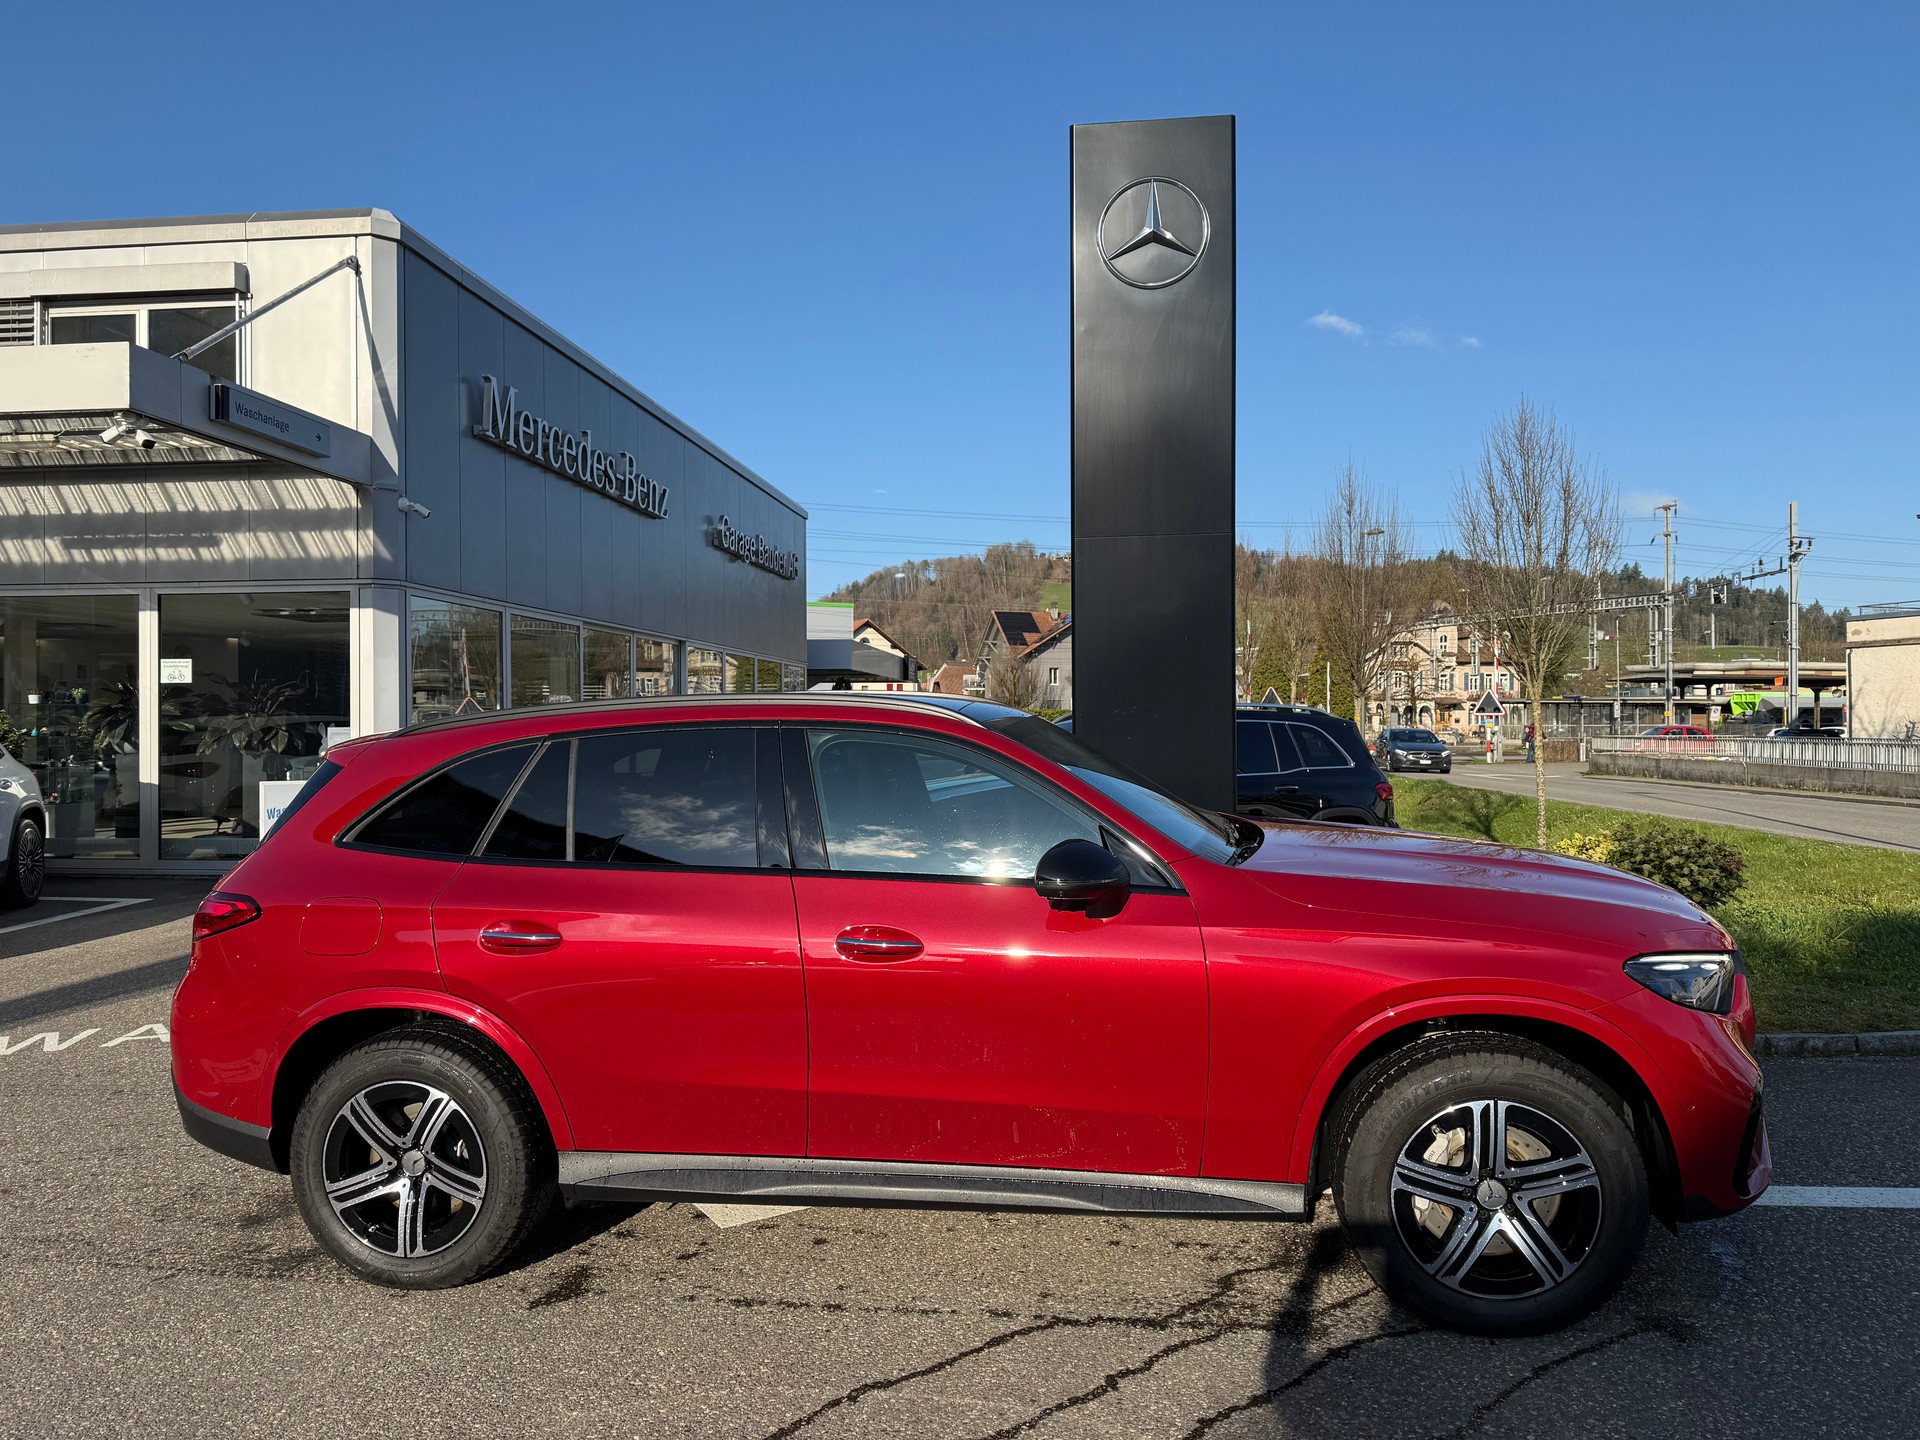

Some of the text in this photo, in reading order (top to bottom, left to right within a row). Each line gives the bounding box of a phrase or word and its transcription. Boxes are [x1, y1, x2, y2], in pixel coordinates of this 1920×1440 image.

[234, 400, 290, 433] Waschanlage
[482, 374, 670, 520] Mercedes-Benz
[718, 515, 756, 564] Garage
[757, 535, 787, 576] Bauder
[1689, 583, 1694, 595] 5
[1734, 574, 1739, 586] 6
